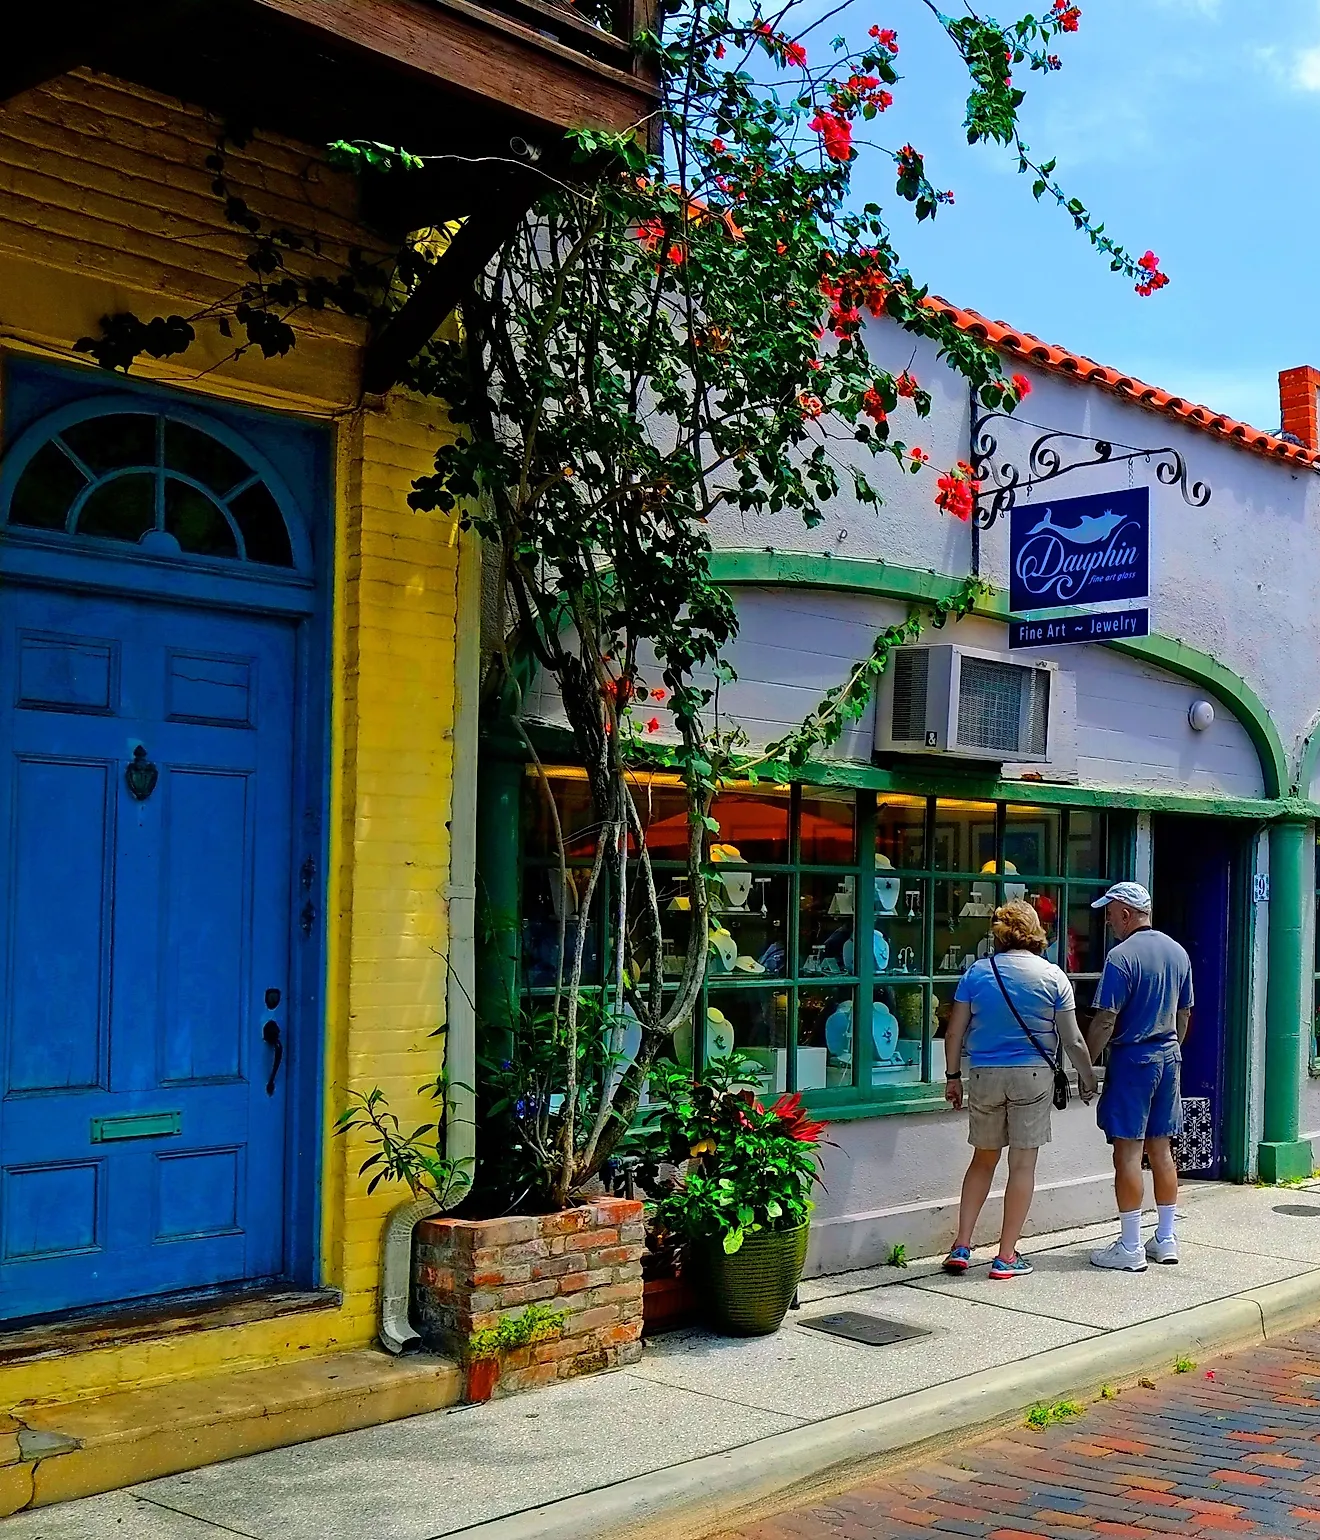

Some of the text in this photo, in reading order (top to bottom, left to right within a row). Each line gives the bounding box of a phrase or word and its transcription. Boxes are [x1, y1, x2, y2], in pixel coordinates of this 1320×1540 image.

[1016, 521, 1141, 600] Dauphin
[1088, 575, 1104, 585] fine
[1105, 573, 1117, 582] art
[1019, 625, 1043, 641] Fine
[1047, 623, 1066, 638] Art
[1090, 616, 1137, 634] Jewelry
[1259, 879, 1266, 896] 9
